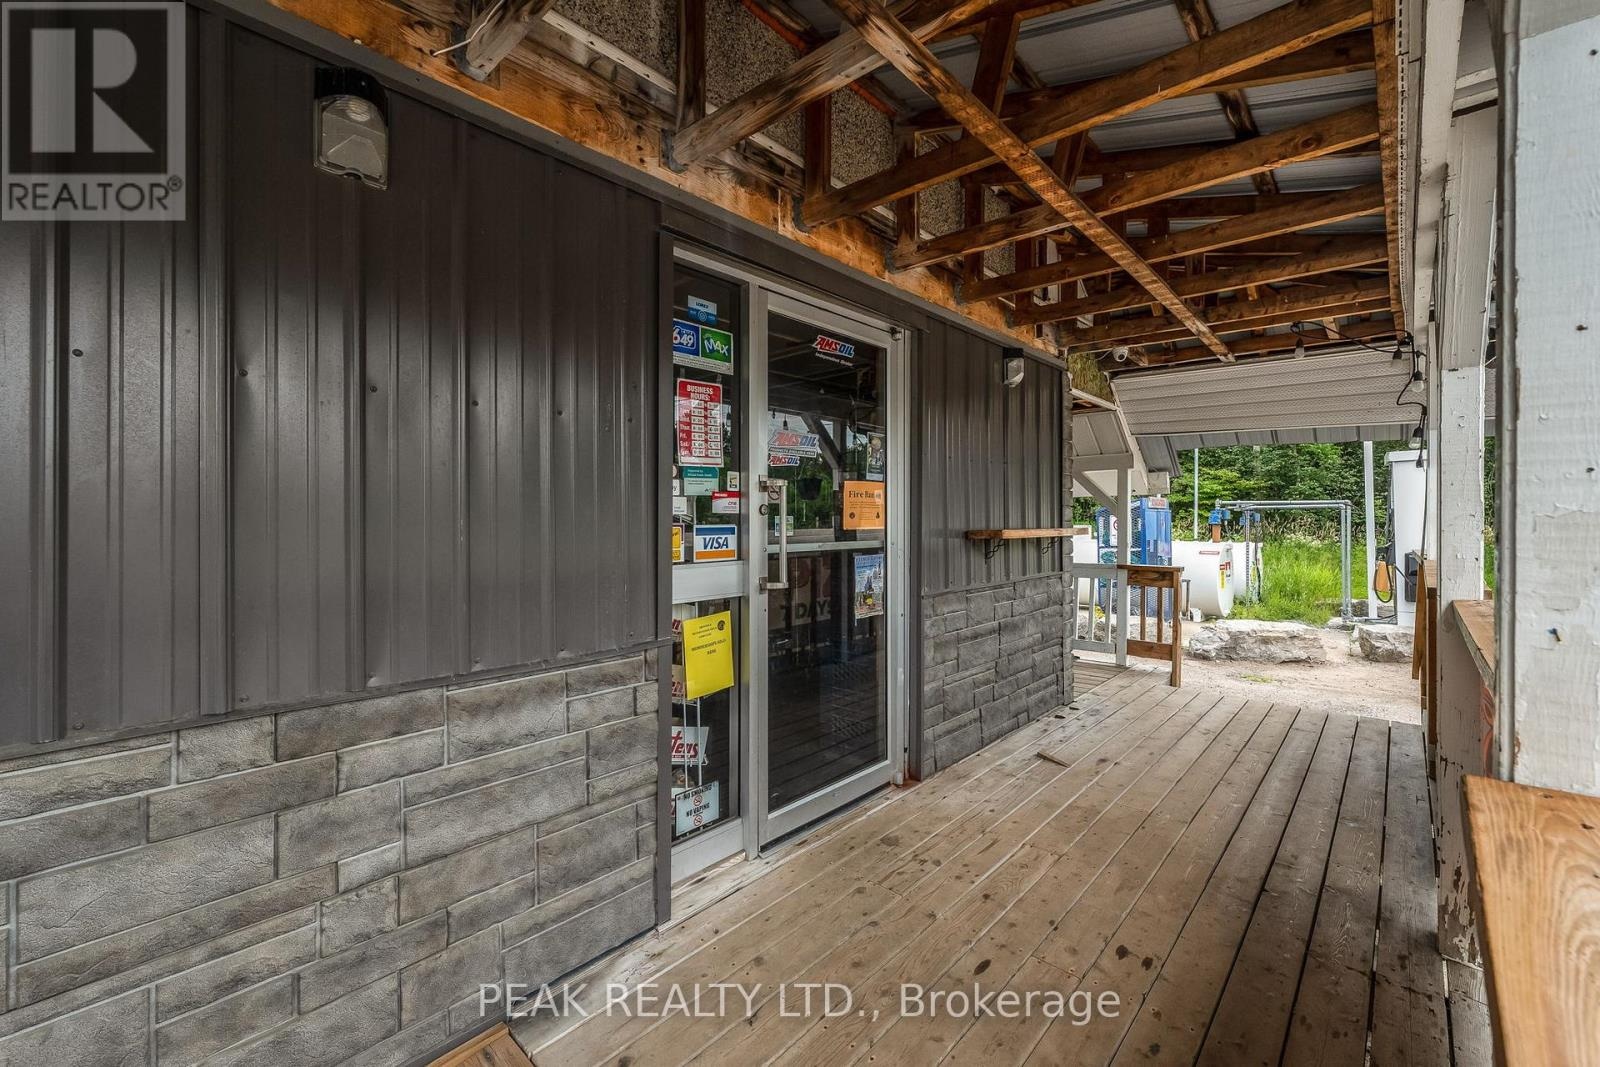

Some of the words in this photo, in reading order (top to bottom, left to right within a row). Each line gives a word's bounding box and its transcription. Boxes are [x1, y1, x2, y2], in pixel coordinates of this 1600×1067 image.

[815, 336, 854, 357] AMSOIL
[687, 384, 714, 395] BUSINESS
[772, 432, 817, 448] AMSOIL
[769, 455, 799, 465] AMSOIL
[848, 490, 864, 498] Fire
[703, 536, 729, 550] VISA
